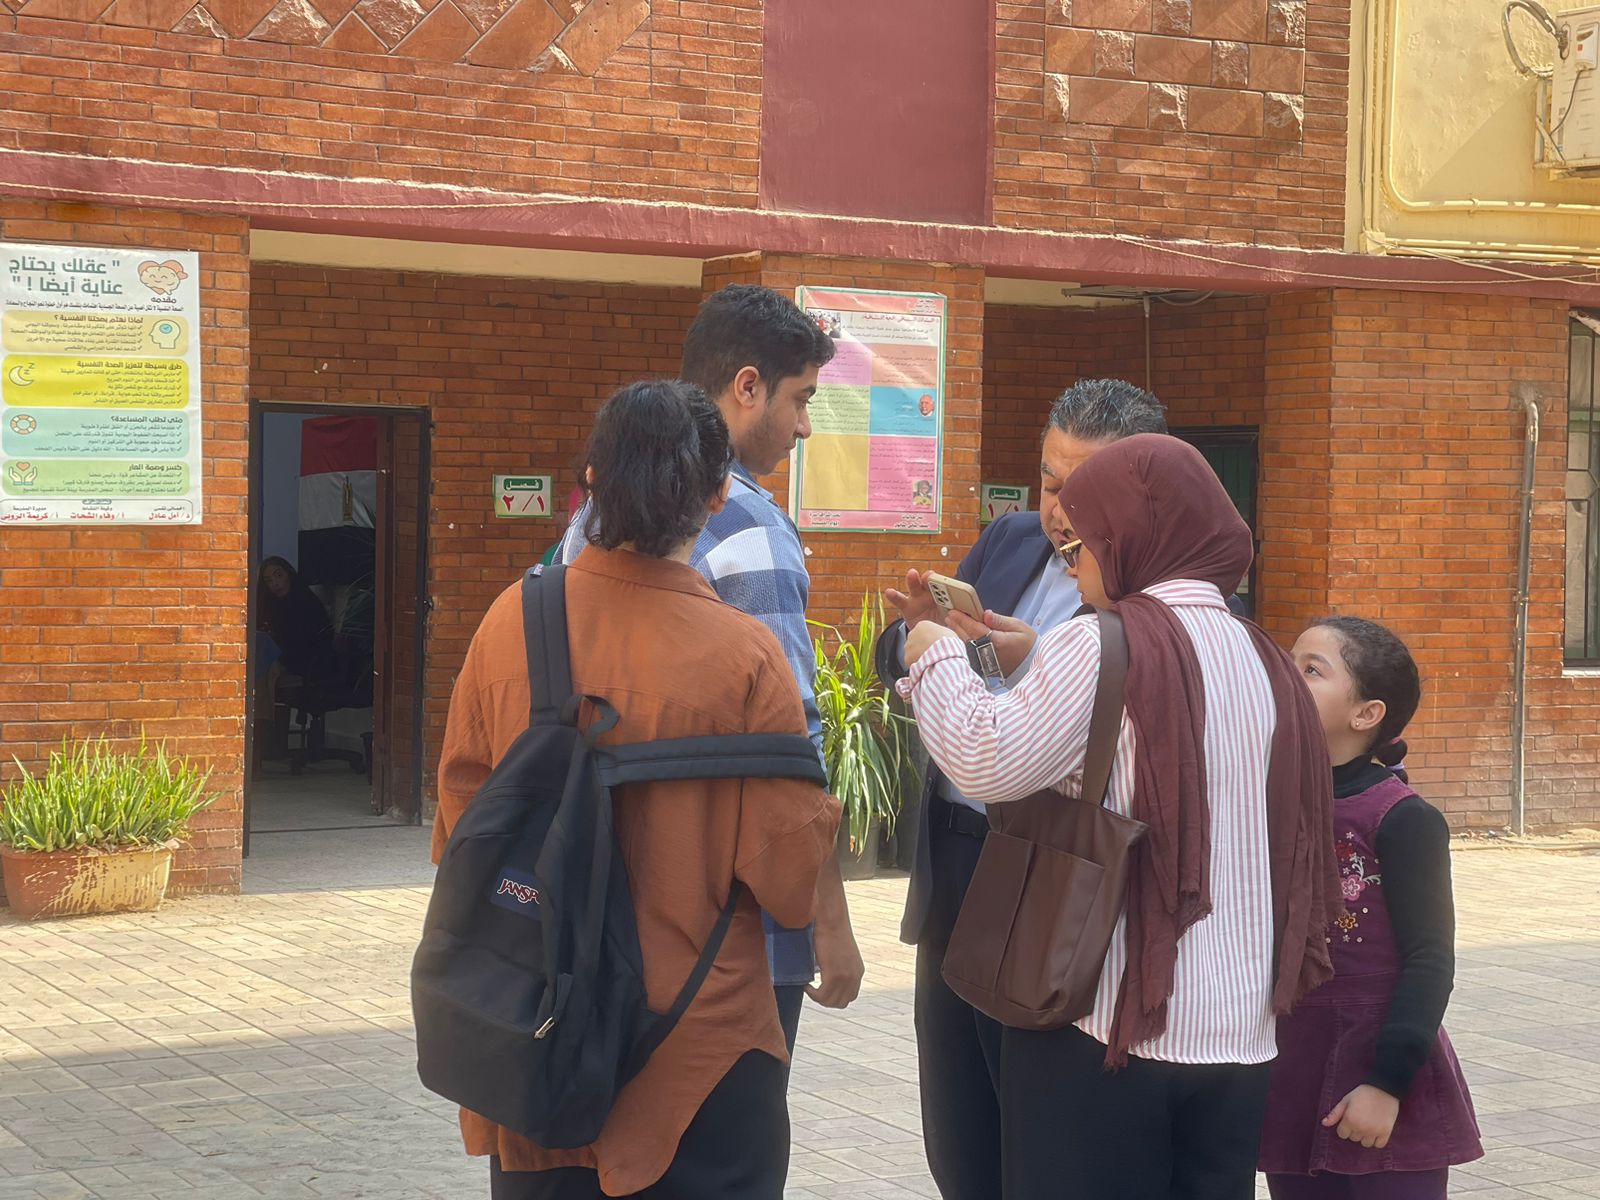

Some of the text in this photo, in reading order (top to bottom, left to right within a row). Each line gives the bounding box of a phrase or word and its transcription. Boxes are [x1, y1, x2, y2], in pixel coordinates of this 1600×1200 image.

[9, 255, 56, 275] يحتاج
[62, 258, 106, 274] عقلك
[81, 277, 122, 297] عناية
[506, 479, 539, 490] فصل
[497, 878, 541, 905] JANSP
